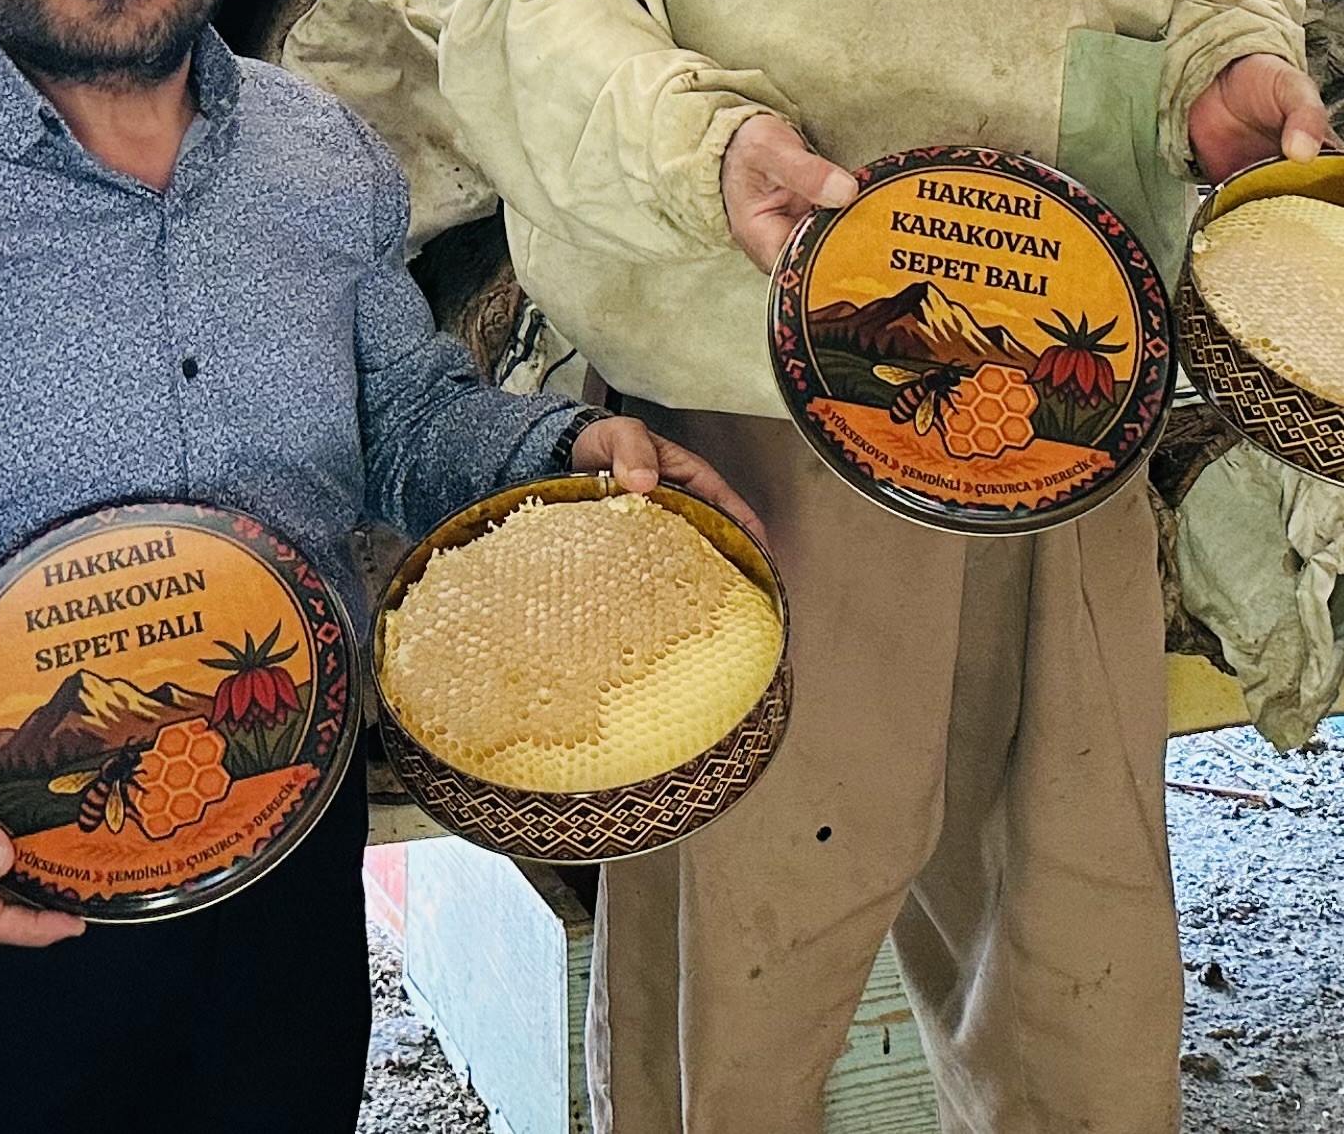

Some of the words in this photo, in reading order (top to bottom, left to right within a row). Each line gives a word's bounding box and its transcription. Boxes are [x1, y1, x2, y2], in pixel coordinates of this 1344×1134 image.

[916, 178, 1042, 221] HAKKARİ
[889, 210, 1062, 262] KARAKOVAN
[889, 248, 981, 284] SEPET
[983, 265, 1049, 297] BALI
[827, 410, 890, 466] YÜKSEKOVA
[899, 463, 961, 492] ŞEMDİNLİ
[974, 479, 1033, 498] ÇUKURCA
[1043, 460, 1094, 488] DERECİK
[42, 530, 177, 587] HAKKARİ
[24, 568, 207, 633] KARAKOVAN
[34, 628, 130, 673] SEPET
[135, 610, 205, 648] BALI
[17, 849, 92, 883] YÜKSEKOVA
[106, 860, 173, 886] ŞEMDİNLİ
[185, 830, 246, 869] ÇUKURCA
